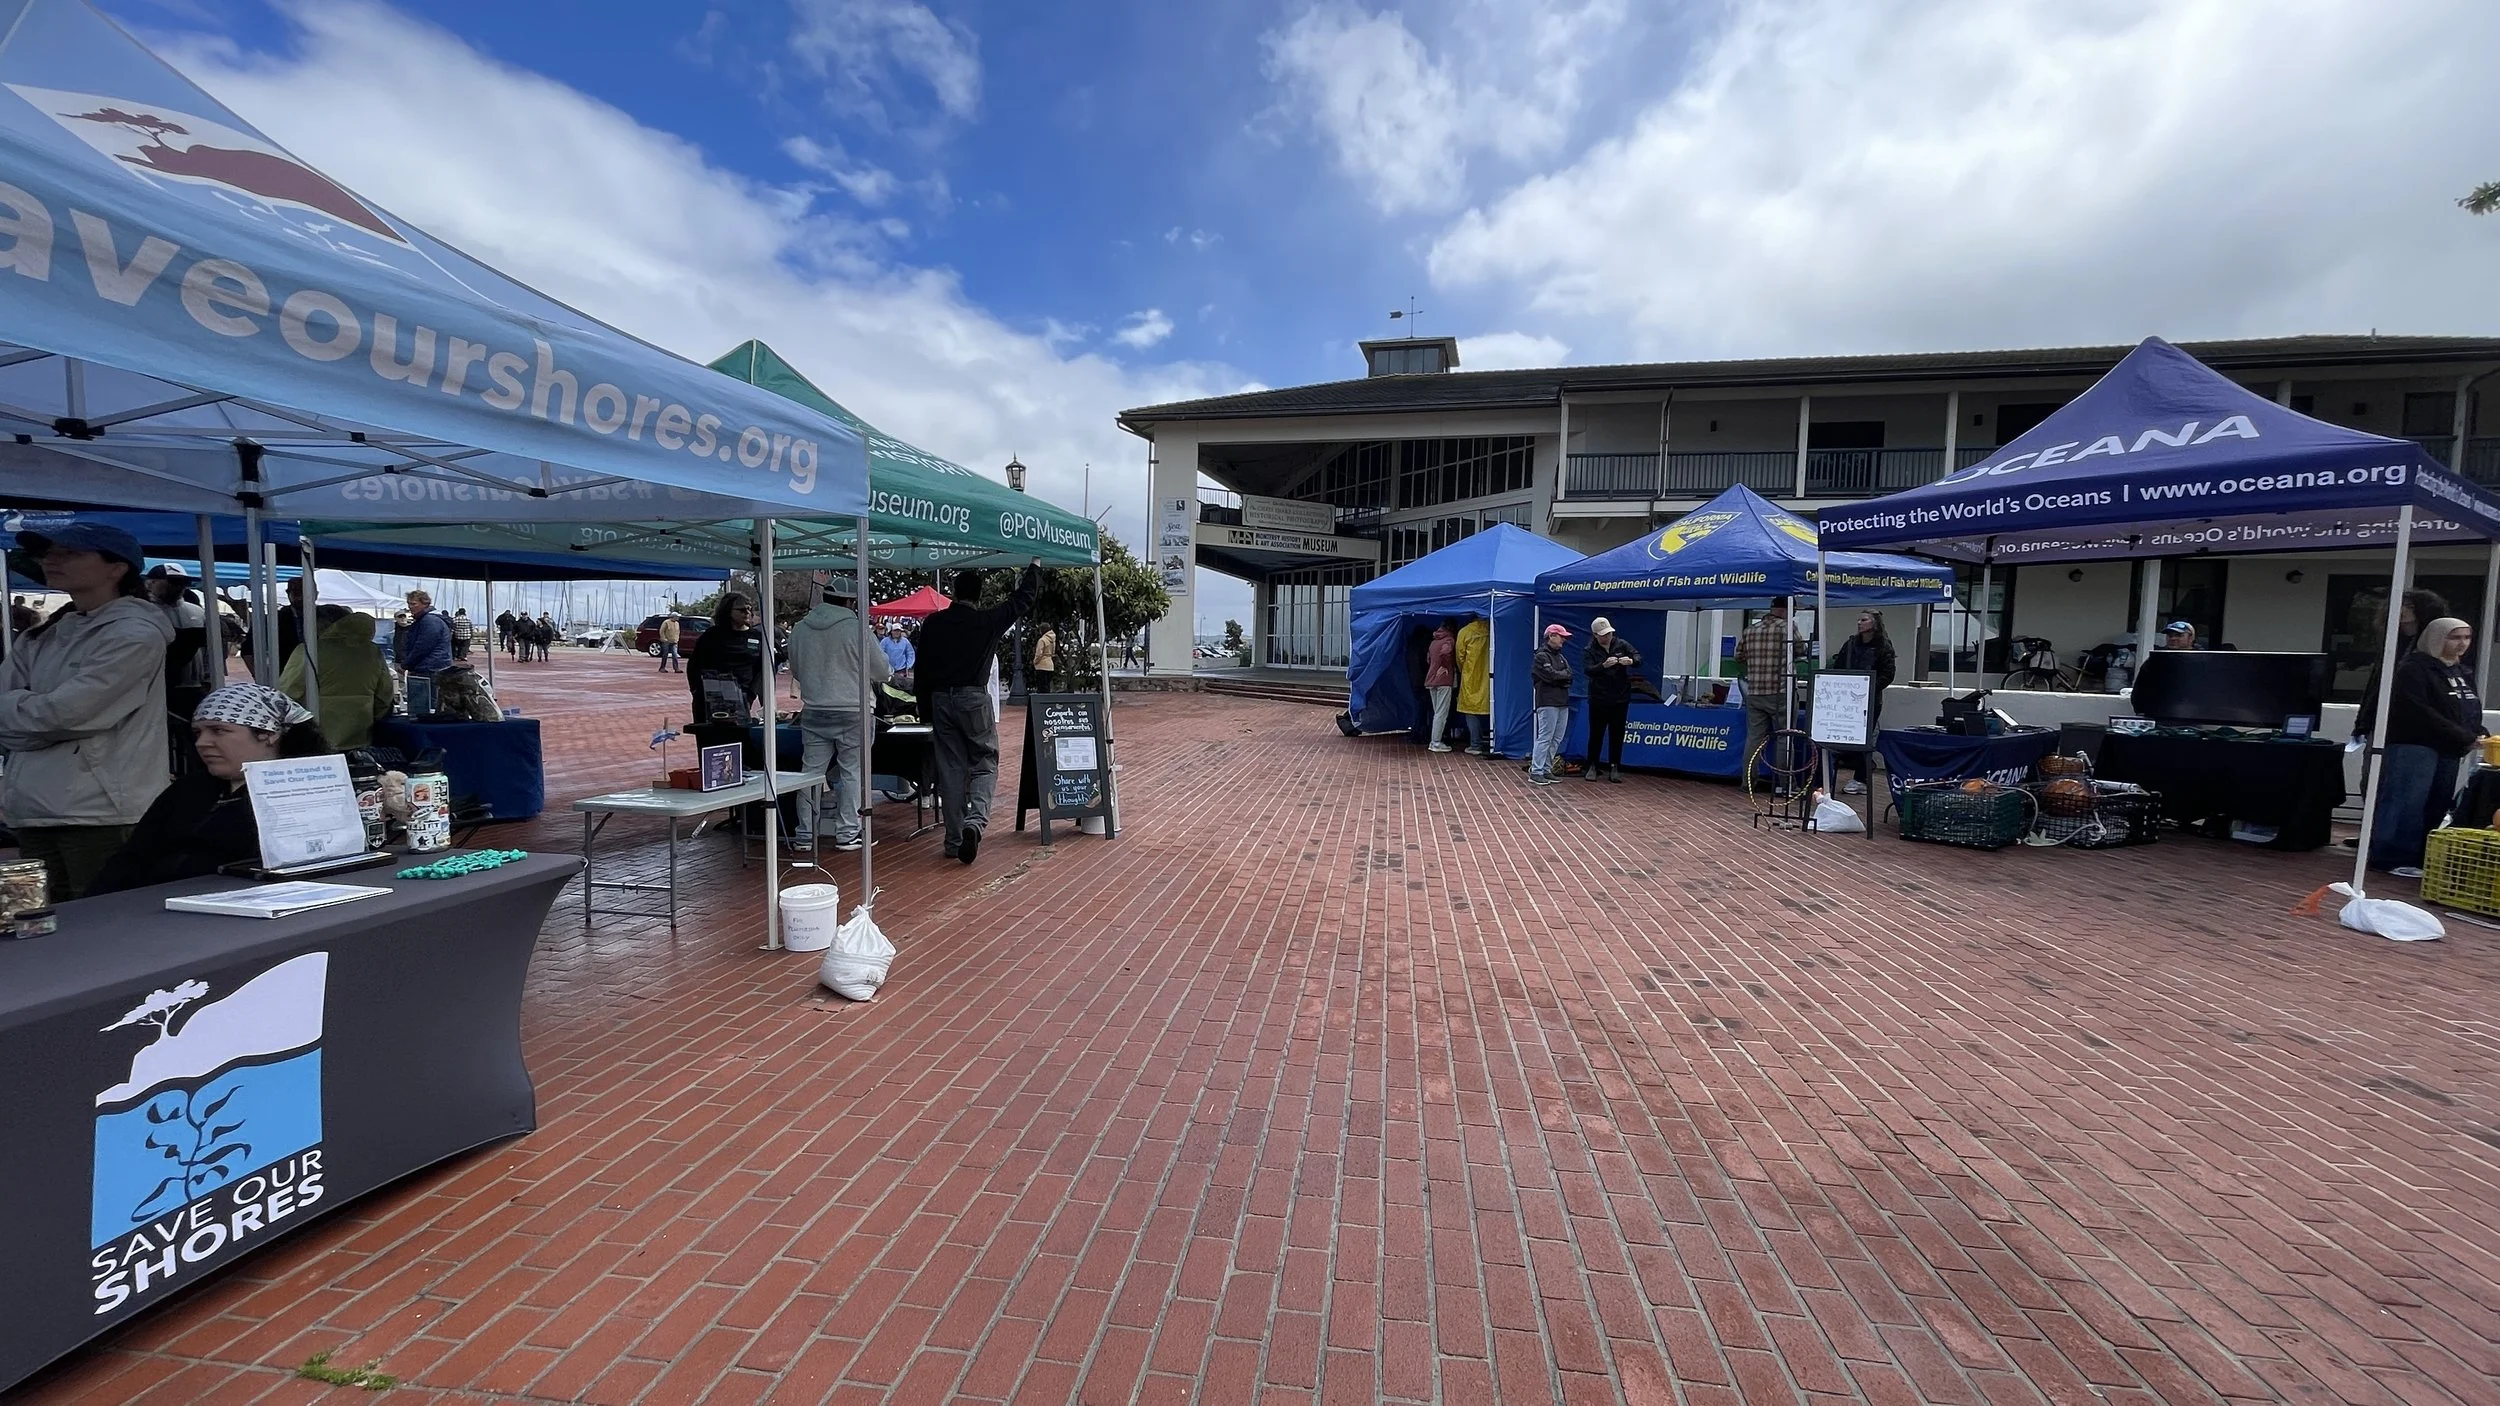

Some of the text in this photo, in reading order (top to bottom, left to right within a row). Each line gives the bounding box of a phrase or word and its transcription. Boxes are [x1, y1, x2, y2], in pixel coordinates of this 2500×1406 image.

[1934, 414, 2261, 487] OCEANA
[1819, 511, 1906, 537] Protecting
[1909, 505, 1940, 525] the
[2024, 487, 2112, 511] Oceans
[2140, 460, 2408, 502] www.oceana.org
[1000, 511, 1092, 550] @PGMuseum
[1302, 538, 1339, 552] MUSEUM
[1549, 571, 1767, 593] California Department of Fish and Wildlife
[1842, 573, 1881, 588] Department
[1880, 576, 1890, 587] of
[1890, 577, 1906, 587] Fish
[1906, 578, 1920, 587] and
[1663, 722, 1718, 735] Department
[1719, 727, 1731, 736] of
[1623, 730, 1728, 751] ish and Wildlife
[294, 766, 320, 774] Stand
[263, 778, 287, 786] Save
[306, 773, 337, 781] Shores
[1053, 774, 1091, 787] Share with
[1058, 793, 1089, 806] thoughts
[92, 1148, 324, 1281] SAVE OUR
[94, 1172, 325, 1316] SHORES
